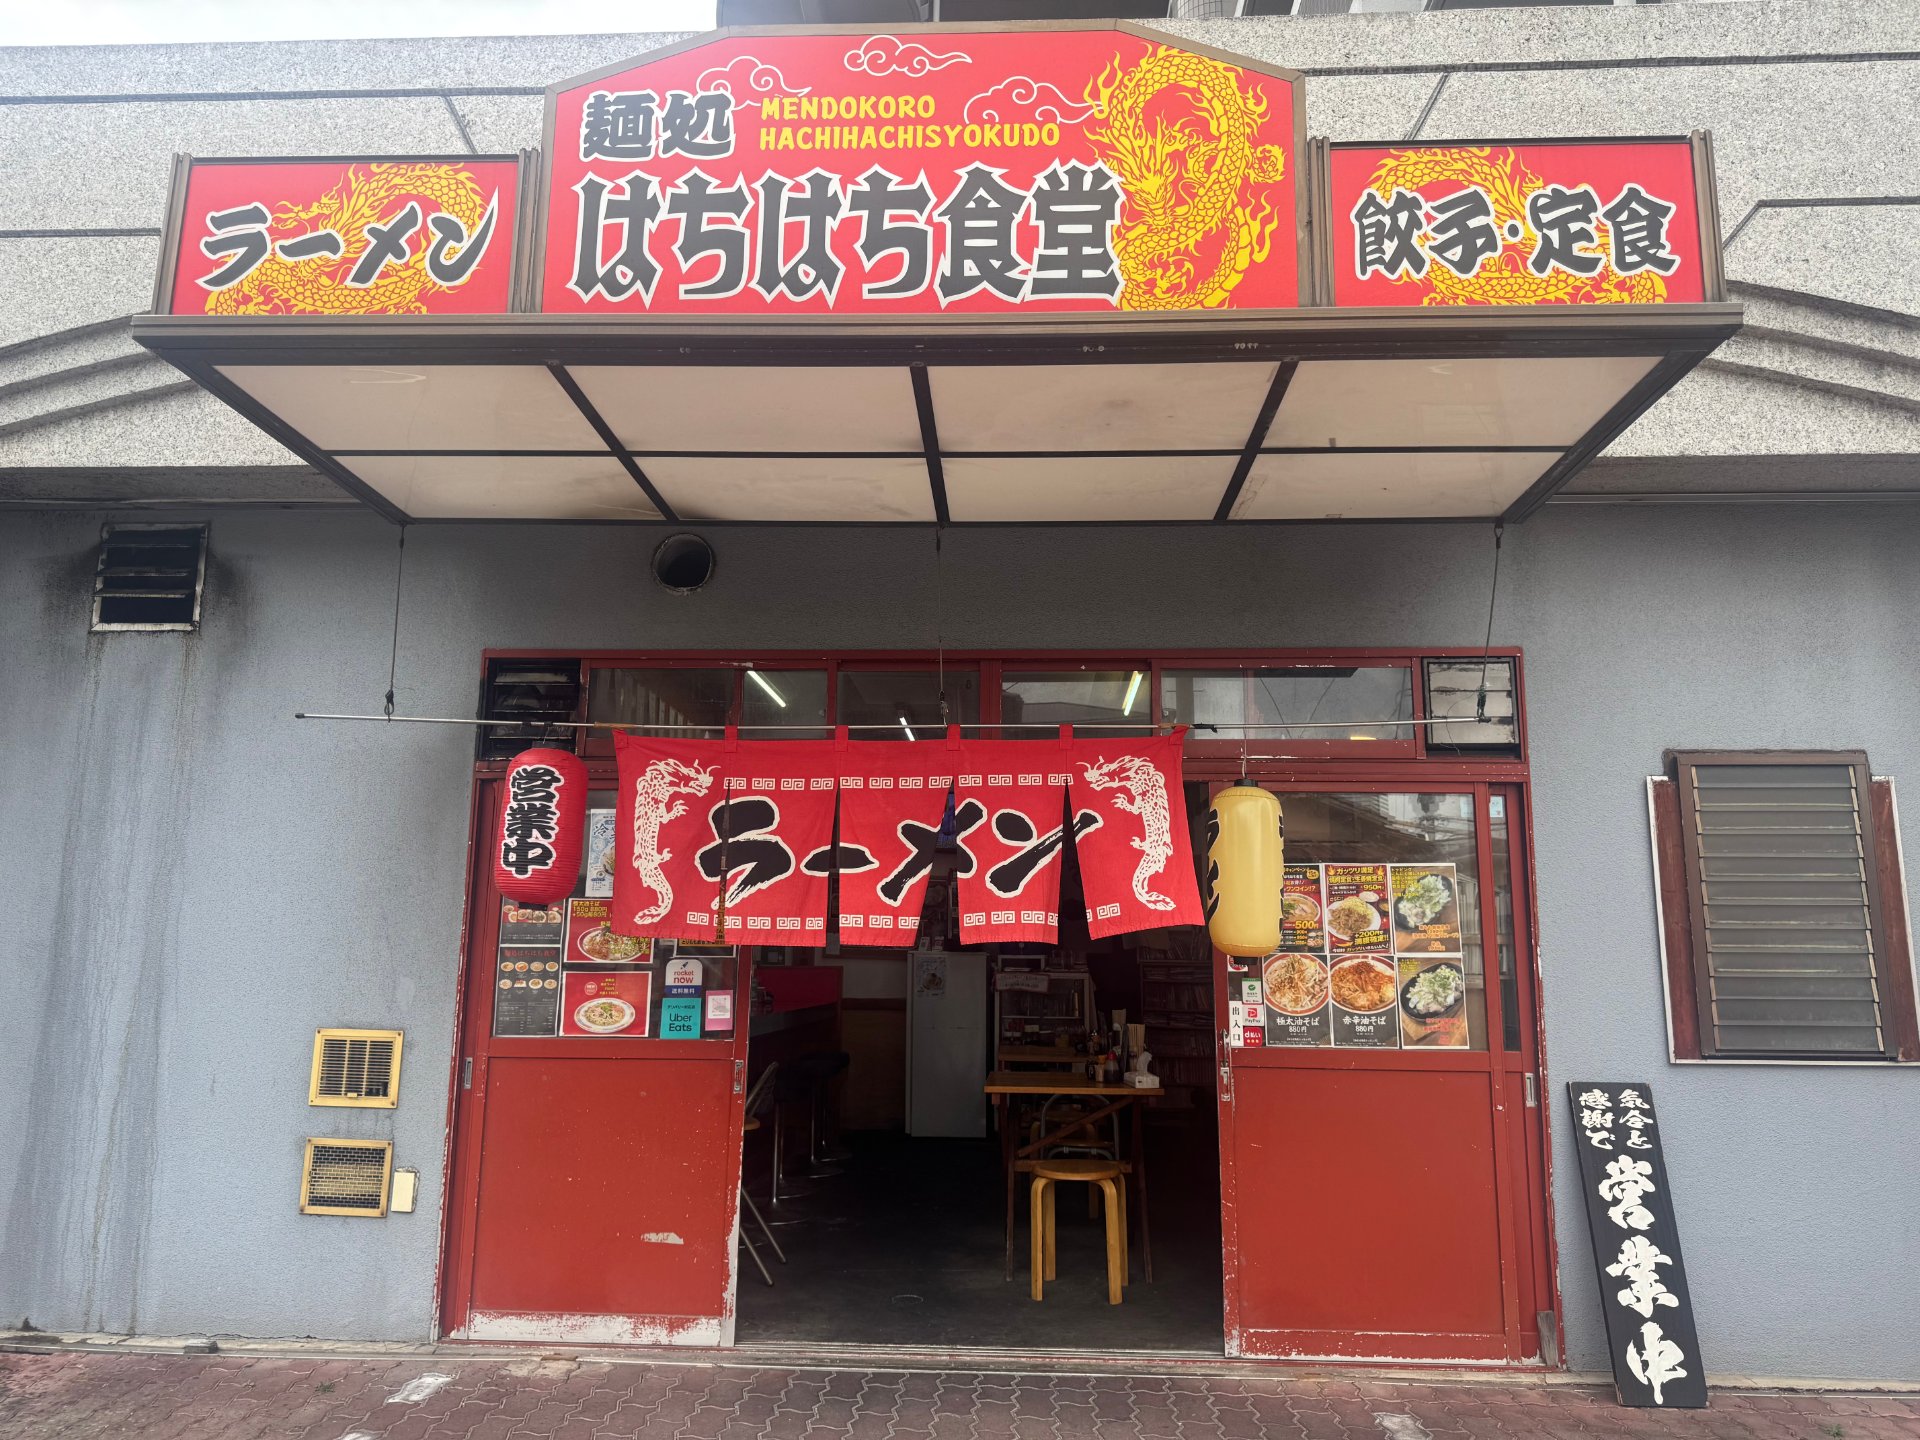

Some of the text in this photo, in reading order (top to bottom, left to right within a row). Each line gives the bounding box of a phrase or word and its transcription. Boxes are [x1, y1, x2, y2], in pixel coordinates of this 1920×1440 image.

[579, 89, 736, 162] 麺処
[759, 122, 1061, 150] HACHIHACHISYOKUDO
[760, 95, 936, 121] MENDOKORO
[195, 187, 499, 291] ラーメン
[566, 158, 1126, 309] はちはち食堂
[1350, 183, 1681, 281] 餃子・定食
[502, 765, 564, 878] 営業中
[694, 795, 1104, 910] ラーメン
[668, 1023, 692, 1032] Eats
[669, 1013, 693, 1022] Uber
[1232, 1006, 1241, 1041] 出入口
[1276, 1016, 1320, 1026] 極太油そば
[1288, 1025, 1307, 1033] 880円
[1578, 1088, 1616, 1150] 感謝で
[1617, 1088, 1654, 1149] 気合と
[1597, 1154, 1688, 1405] 営業中
